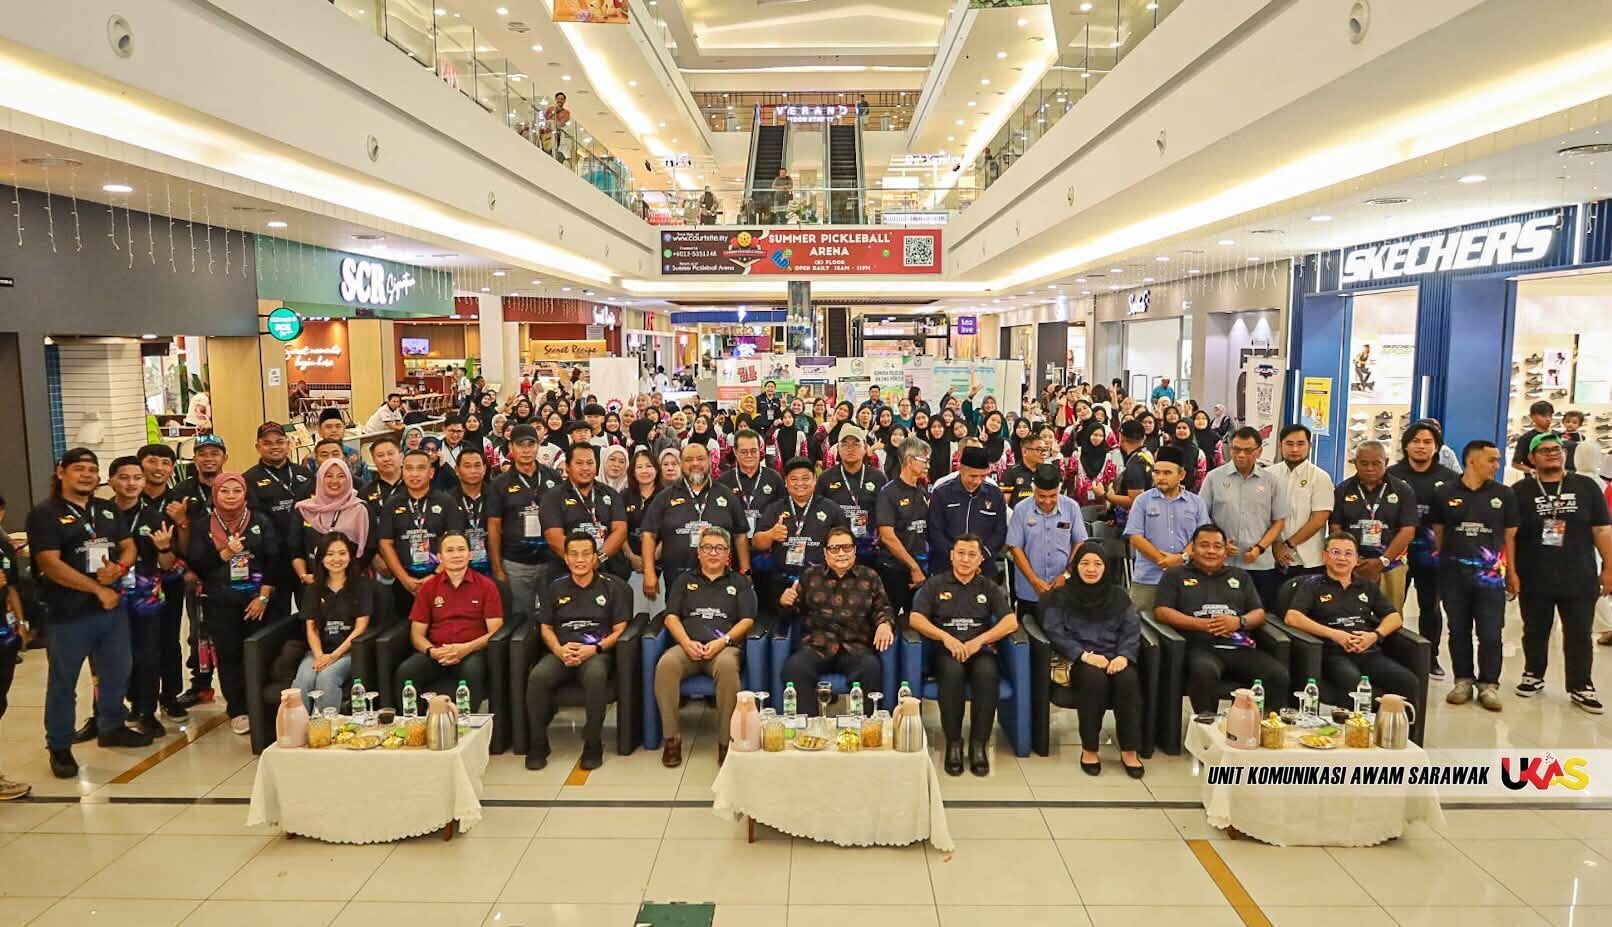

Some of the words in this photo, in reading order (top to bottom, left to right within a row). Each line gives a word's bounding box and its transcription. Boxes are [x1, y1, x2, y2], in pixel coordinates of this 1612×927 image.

[768, 234, 816, 243] SUMMER
[821, 234, 890, 243] PICKLEBALL
[809, 246, 849, 256] ARENA
[1342, 214, 1561, 283] SKECHERS
[544, 345, 570, 355] Secret
[571, 344, 597, 356] Recipe
